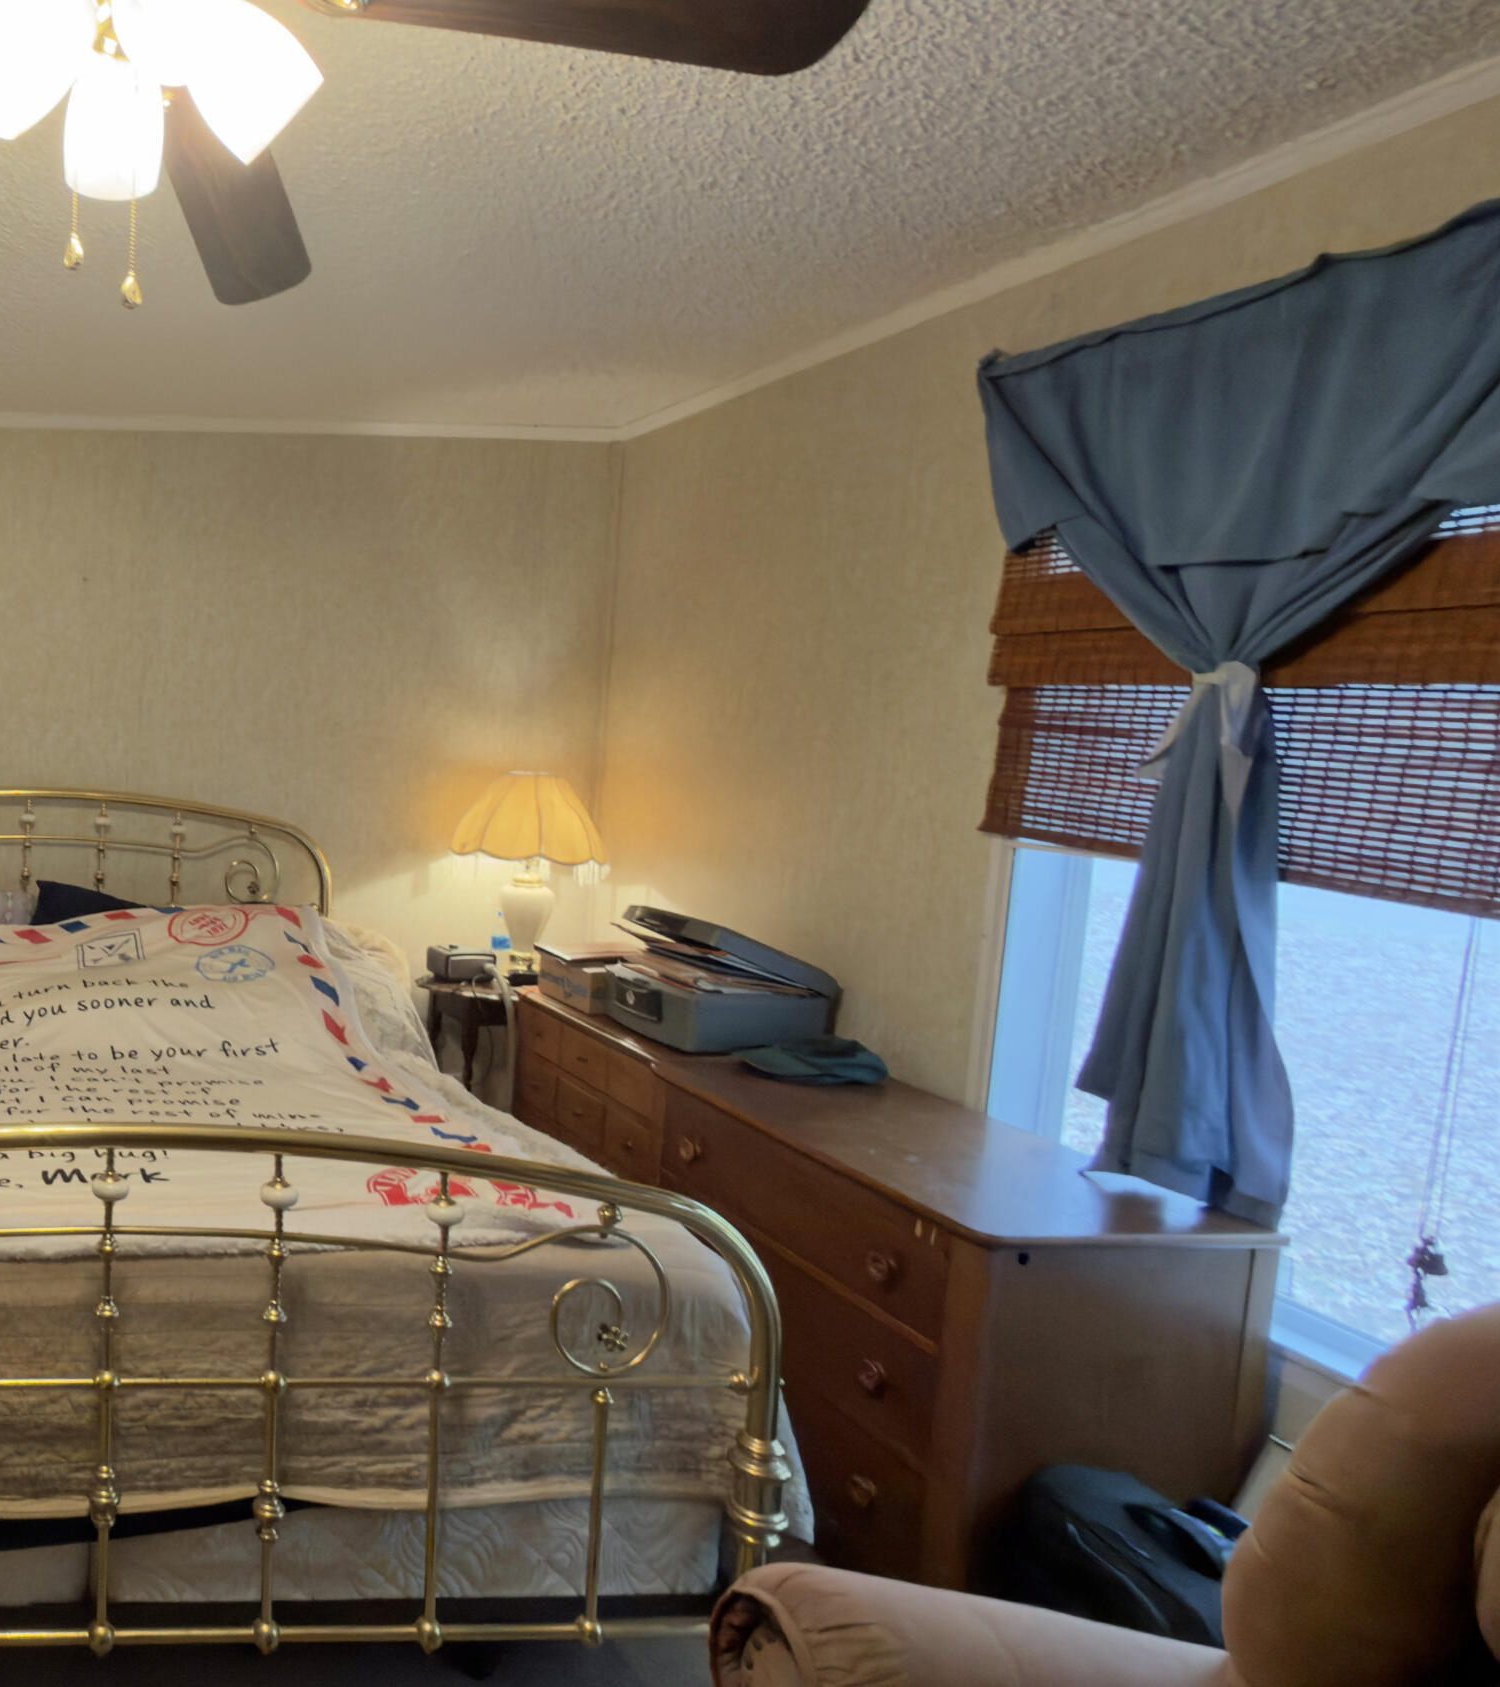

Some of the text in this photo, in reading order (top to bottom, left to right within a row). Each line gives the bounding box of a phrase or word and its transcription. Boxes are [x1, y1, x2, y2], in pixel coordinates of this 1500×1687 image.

[83, 976, 139, 988] back
[151, 979, 189, 988] the
[23, 1001, 67, 1026] you
[77, 996, 158, 1012] sooner
[170, 994, 216, 1010] and
[71, 1050, 99, 1061] to
[110, 1045, 139, 1061] be
[150, 1047, 208, 1062] your
[220, 1037, 280, 1058] first
[34, 1062, 61, 1073] of
